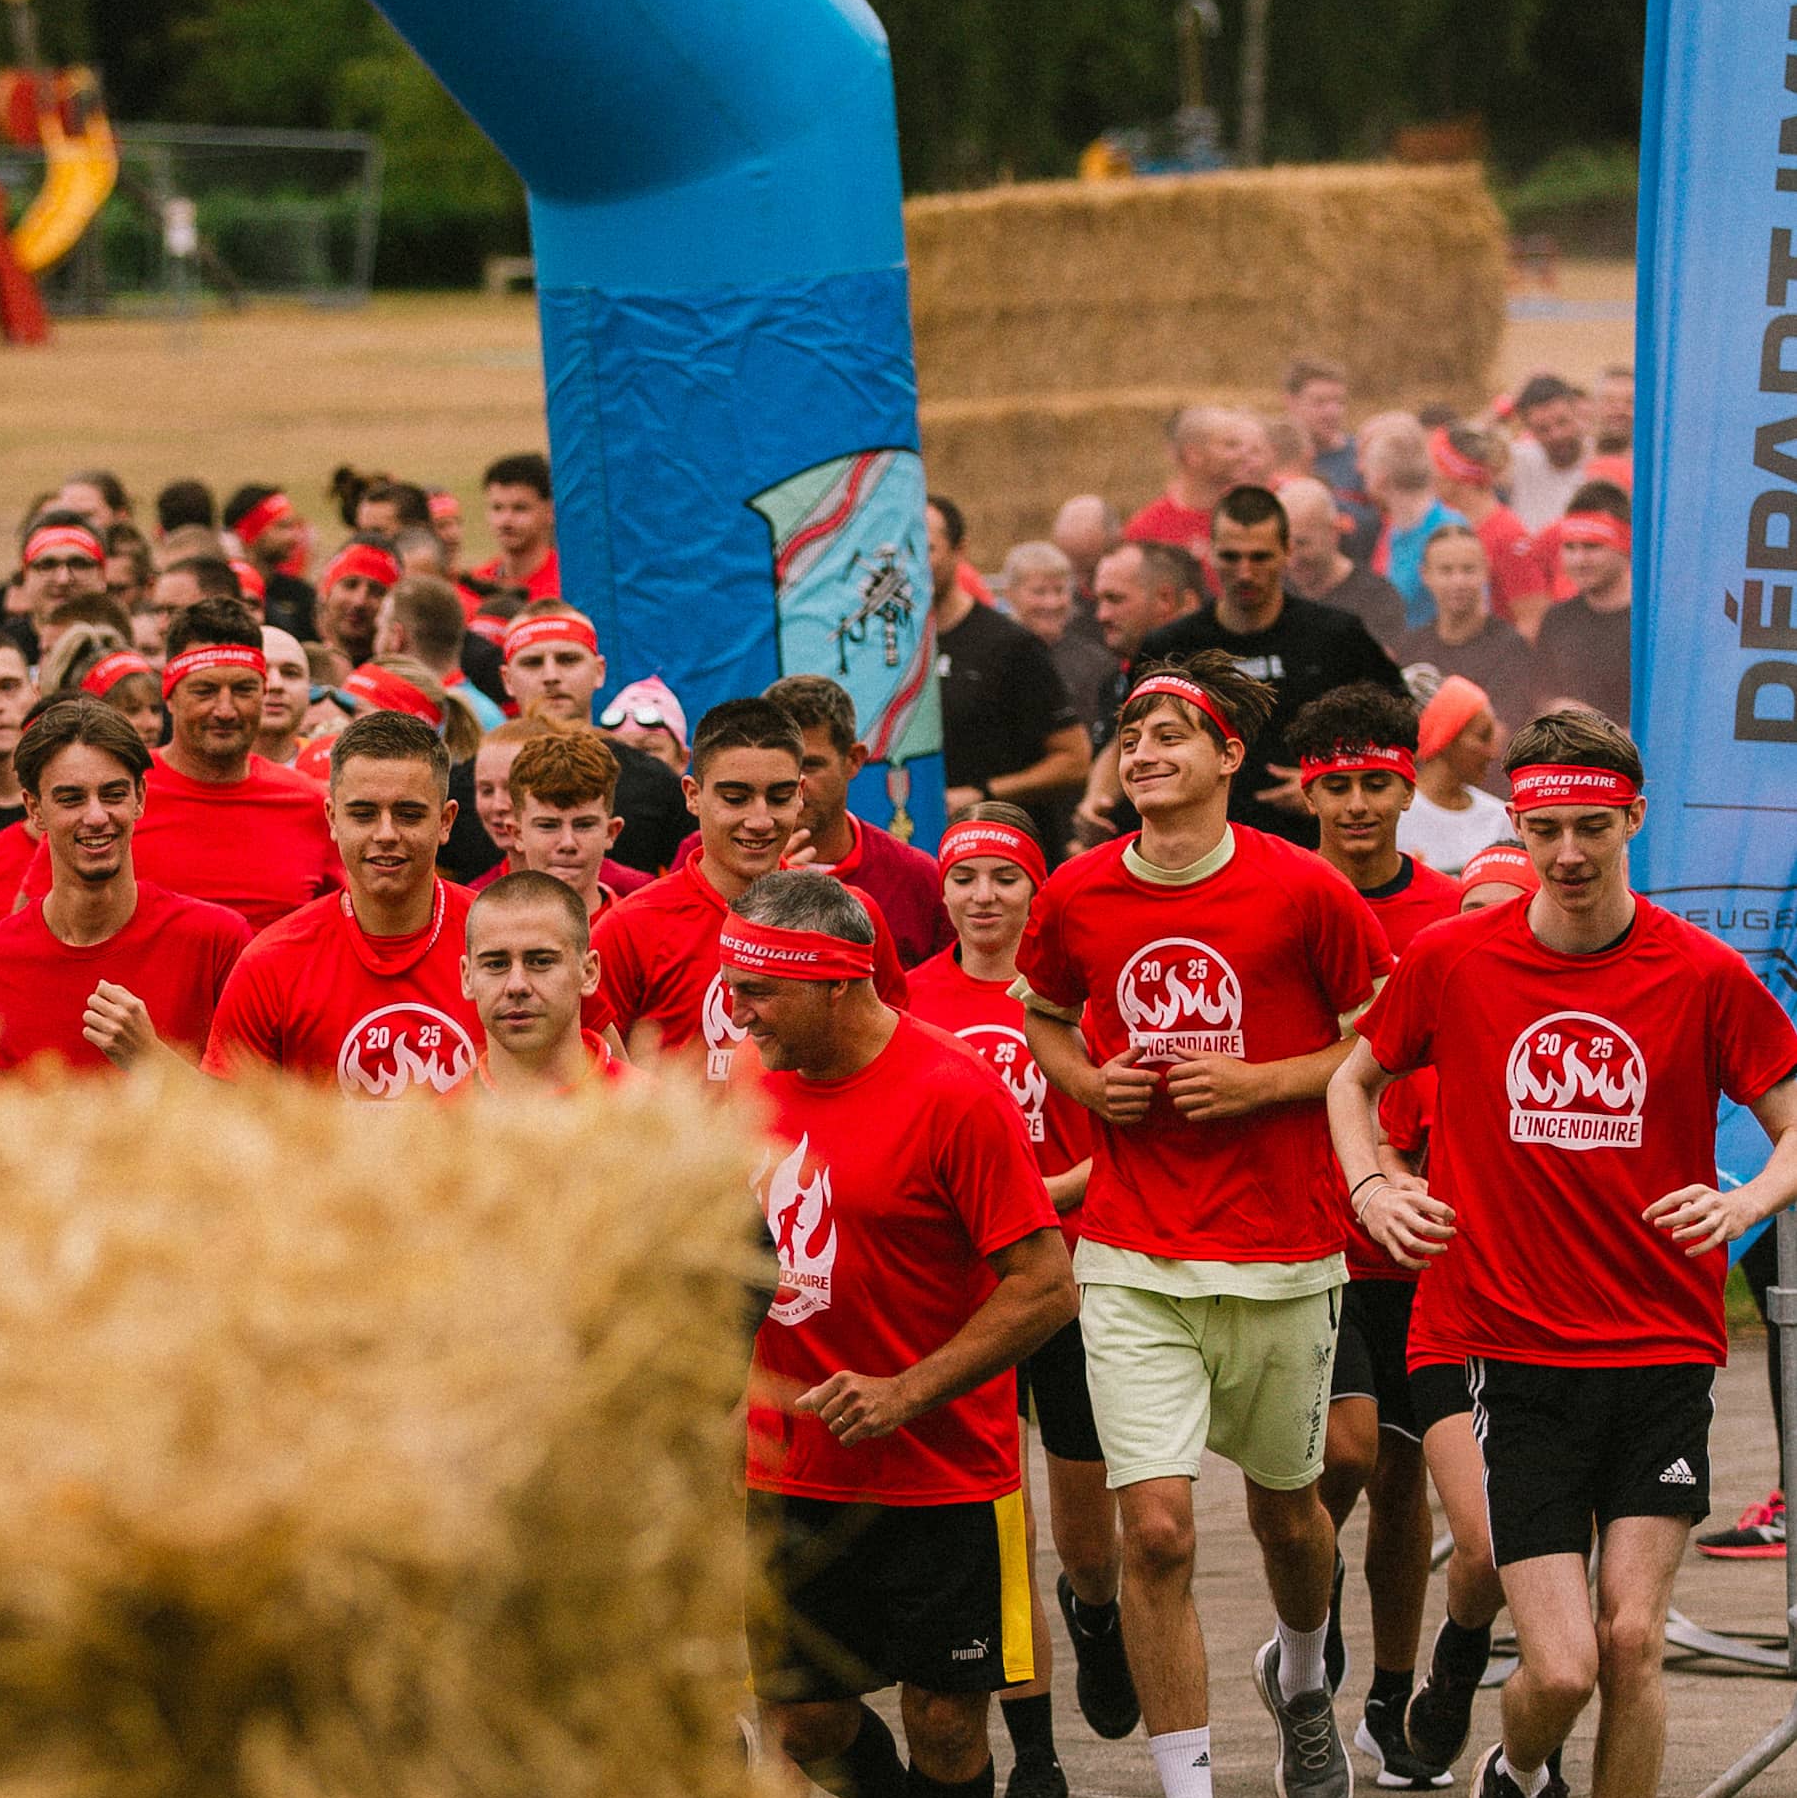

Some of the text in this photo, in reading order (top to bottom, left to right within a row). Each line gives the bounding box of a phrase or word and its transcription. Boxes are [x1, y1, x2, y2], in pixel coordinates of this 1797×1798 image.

[1536, 787, 1571, 798] 2025
[733, 952, 765, 967] 2025
[1140, 958, 1209, 982] 20 25
[366, 1024, 442, 1050] 20 25
[1535, 1032, 1615, 1059] 20 25
[993, 1042, 1018, 1063] 25
[1513, 1115, 1640, 1142] L'INCENDIAIRE
[952, 1647, 984, 1660] PUMA
